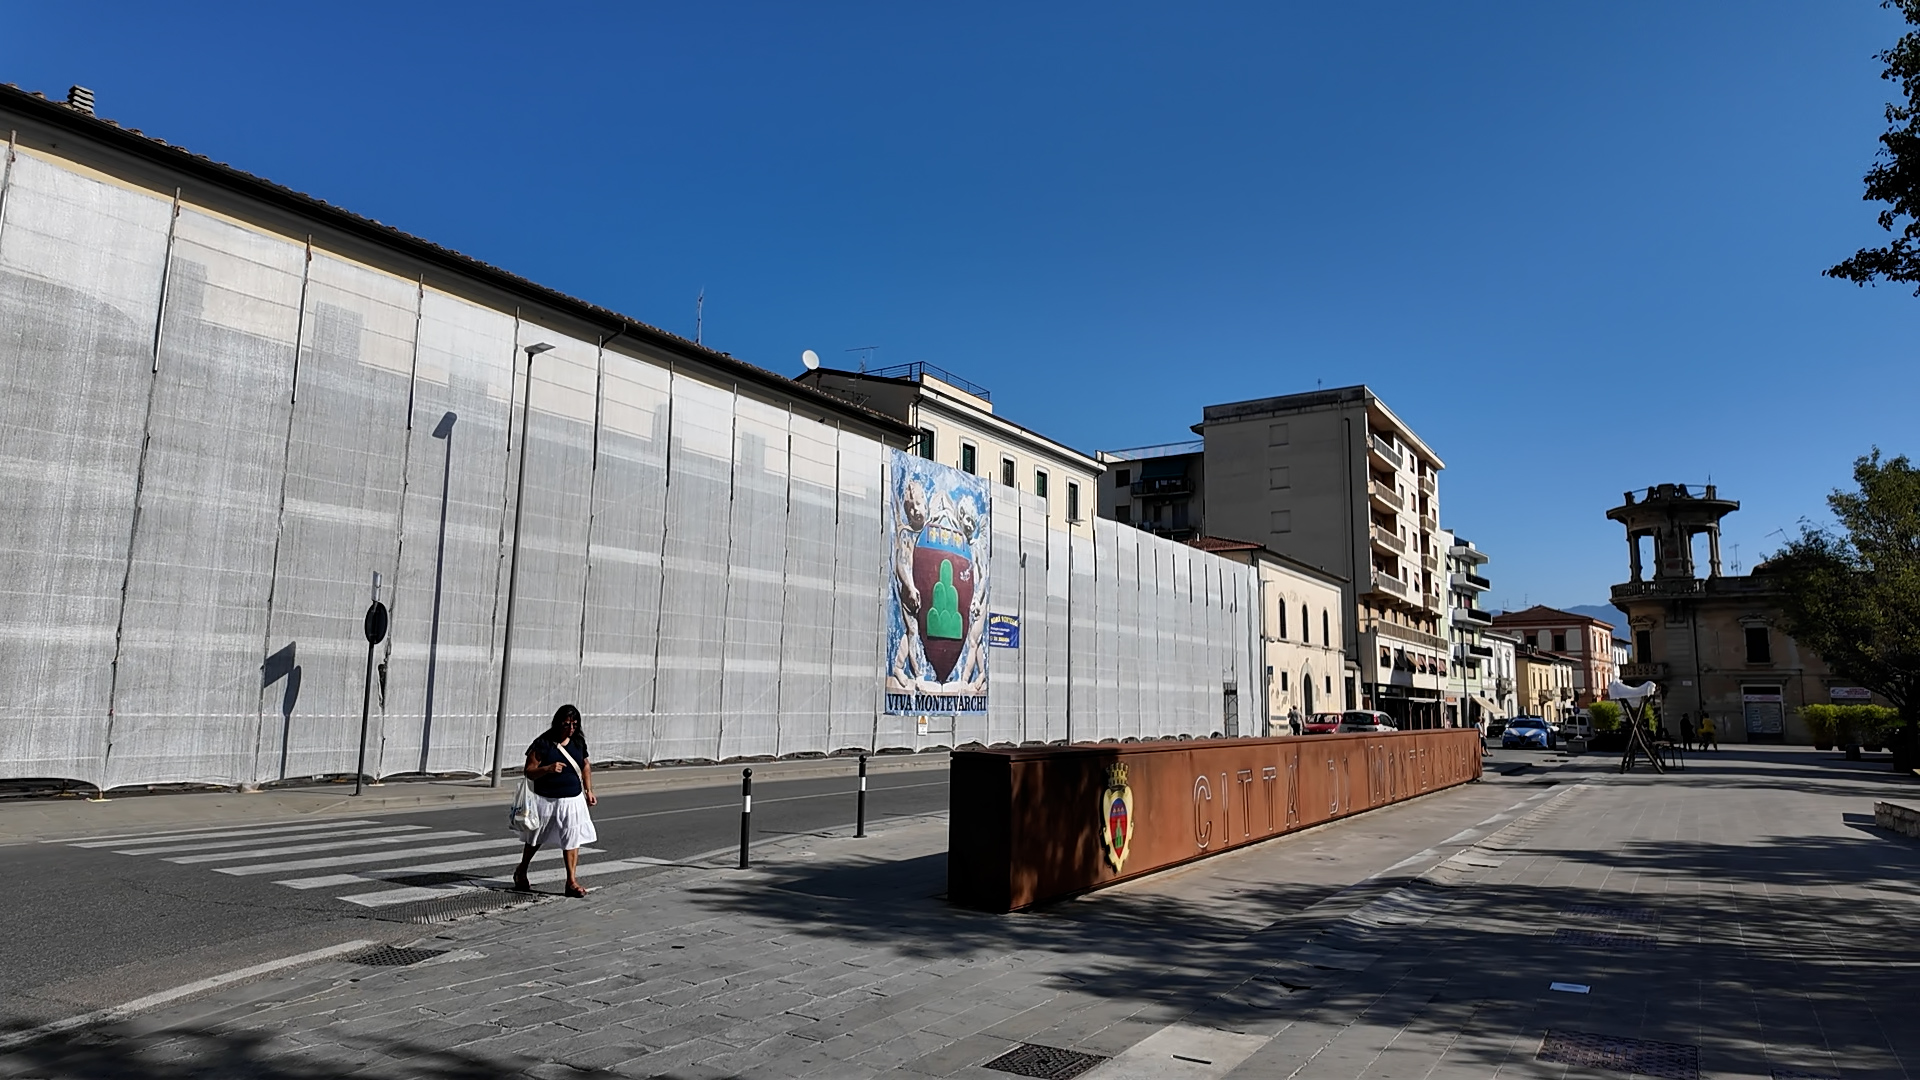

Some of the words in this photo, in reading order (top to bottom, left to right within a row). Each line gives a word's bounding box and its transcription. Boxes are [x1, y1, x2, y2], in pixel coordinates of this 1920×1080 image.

[887, 693, 913, 711] VIVA
[915, 694, 987, 712] MONTEVARCHI
[1327, 757, 1350, 815] DI
